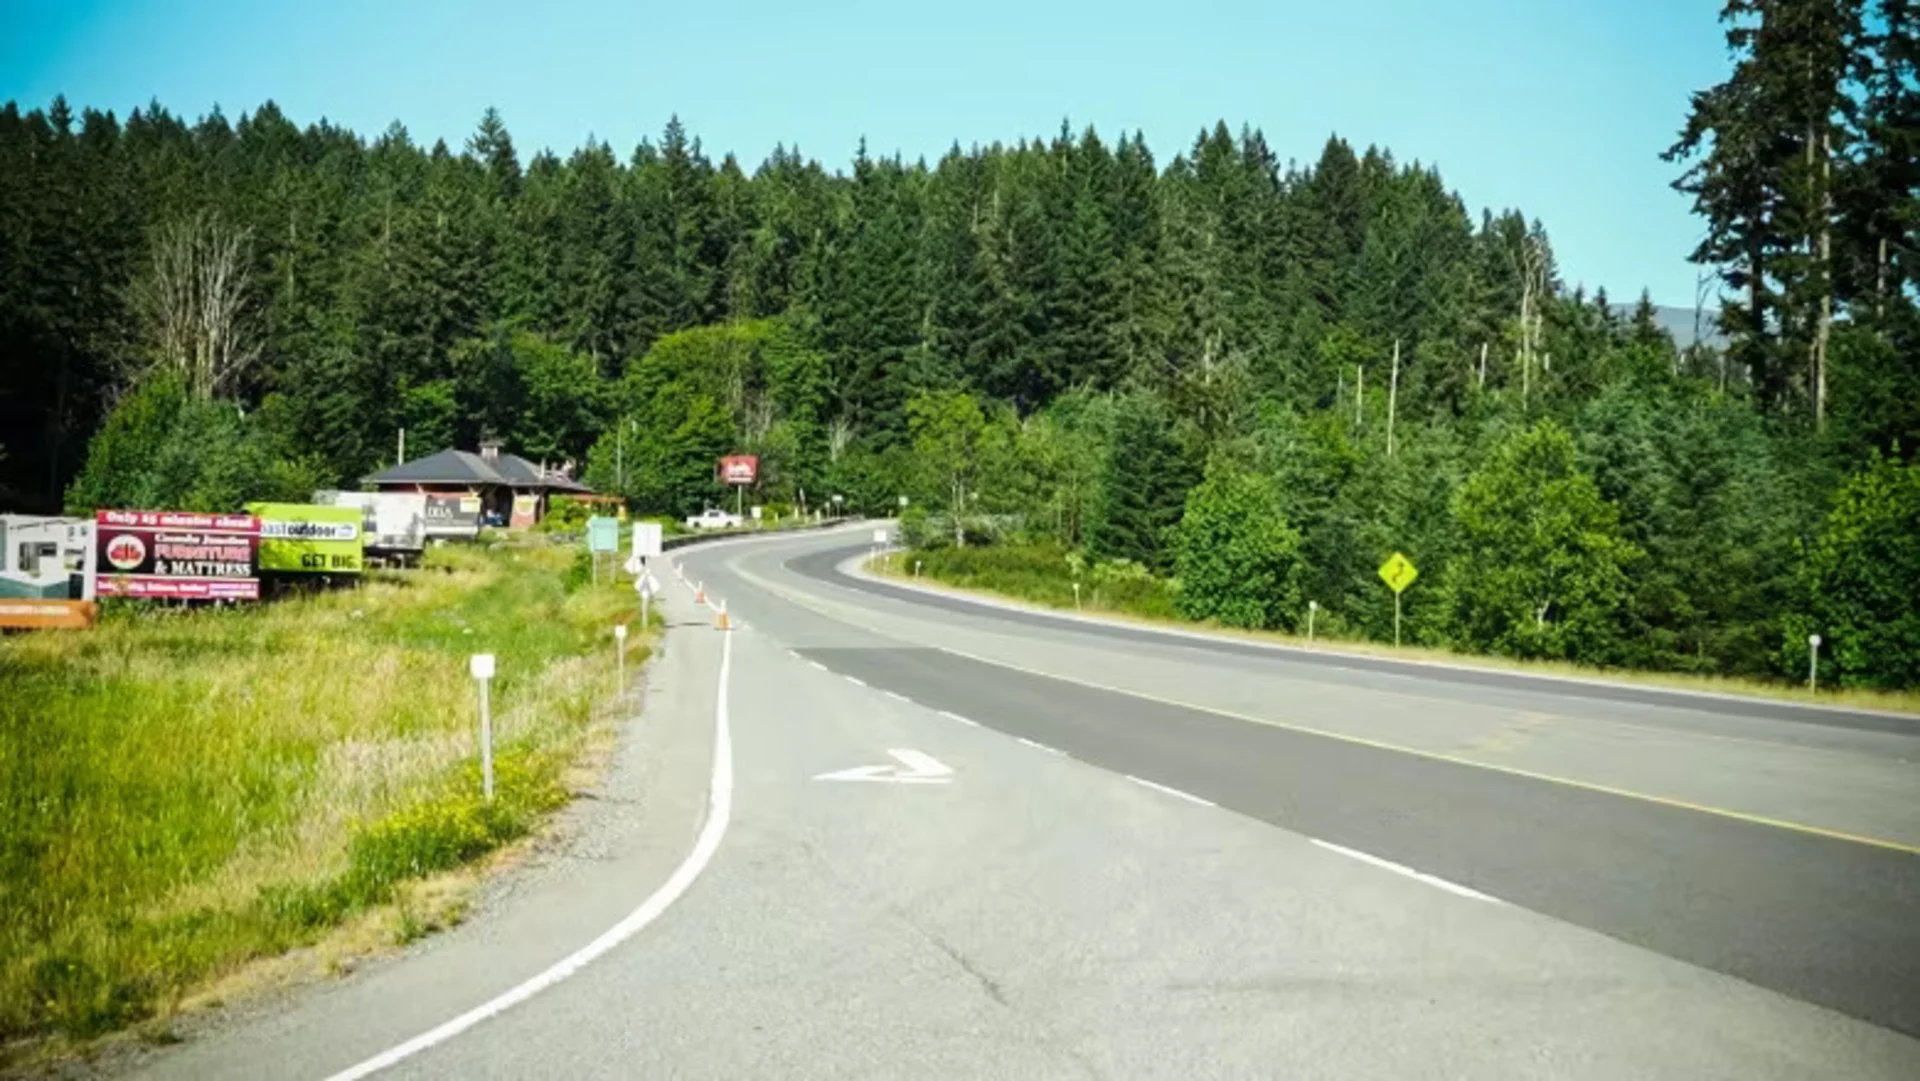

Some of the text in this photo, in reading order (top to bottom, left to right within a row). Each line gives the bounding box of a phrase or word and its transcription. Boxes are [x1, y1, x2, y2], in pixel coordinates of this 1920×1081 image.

[107, 511, 138, 525] Only
[155, 544, 250, 561] FURNITURE
[301, 553, 326, 567] GET
[155, 561, 251, 576] & MATTRESS
